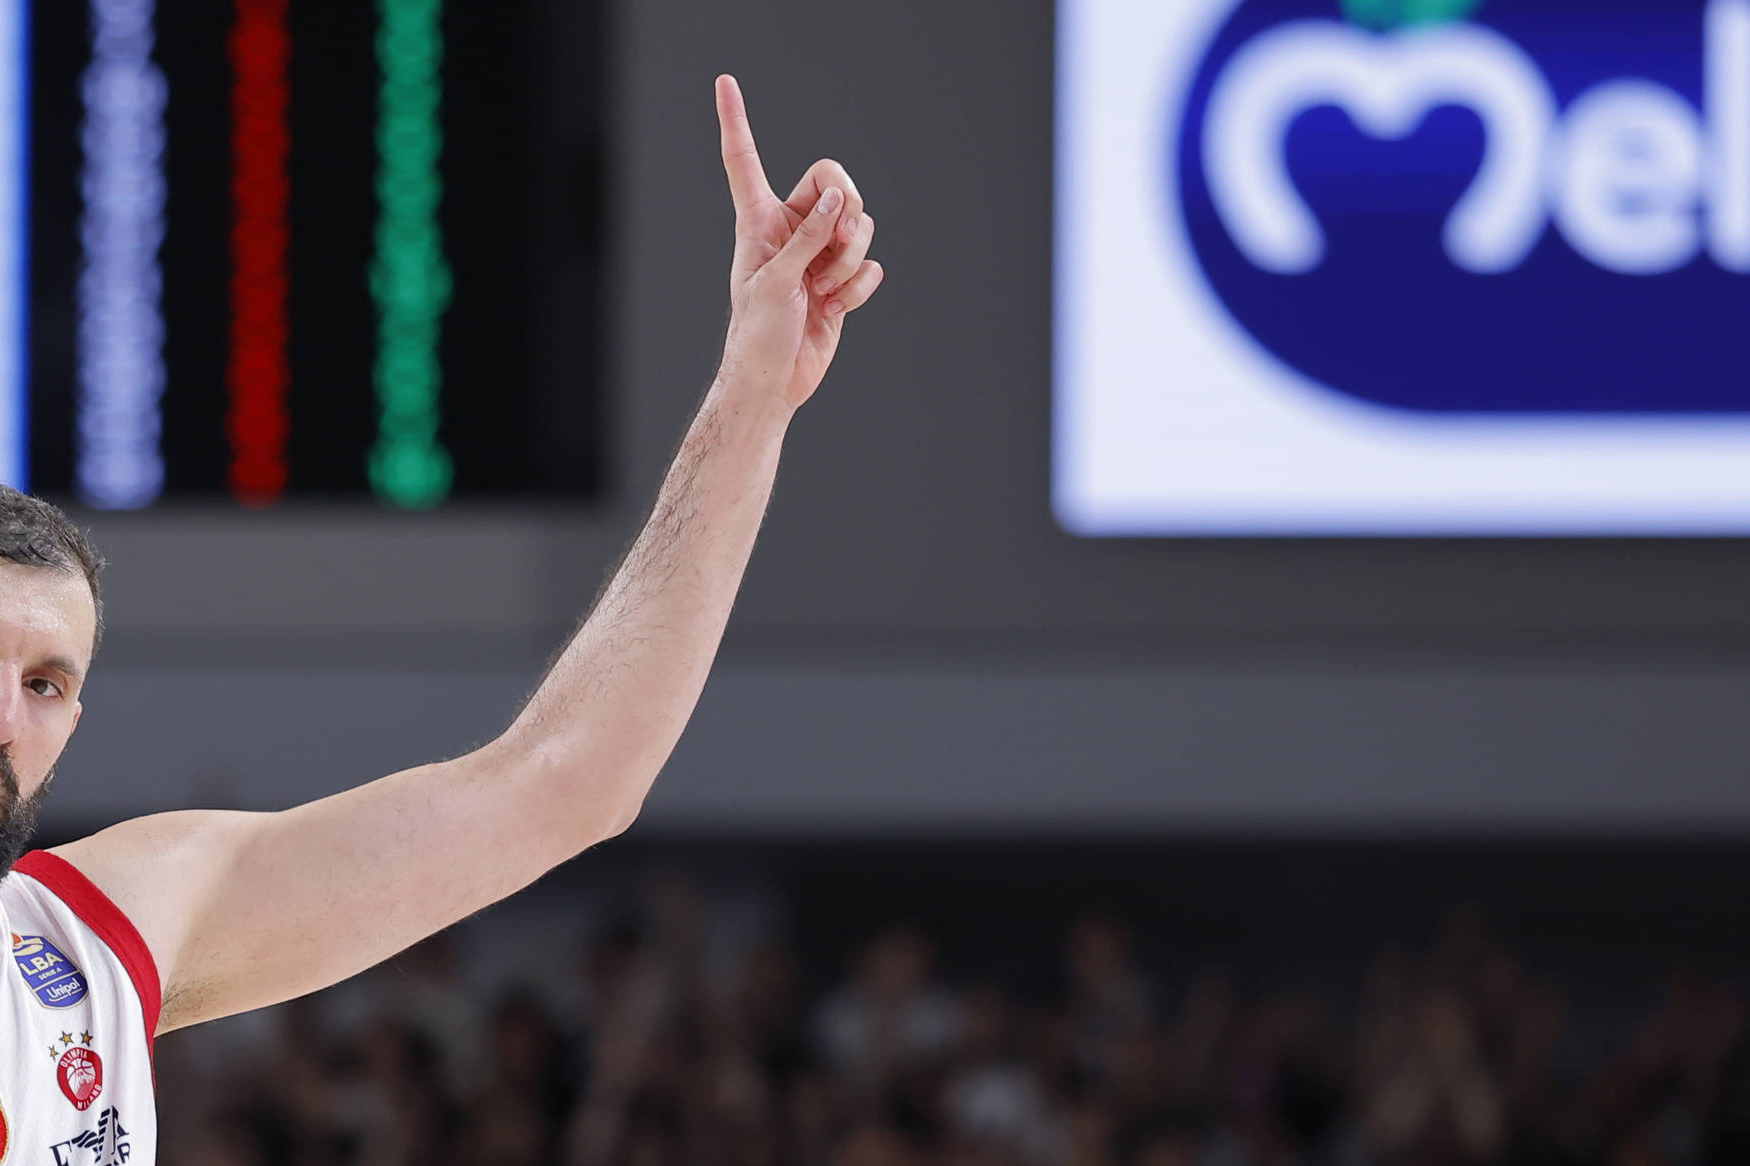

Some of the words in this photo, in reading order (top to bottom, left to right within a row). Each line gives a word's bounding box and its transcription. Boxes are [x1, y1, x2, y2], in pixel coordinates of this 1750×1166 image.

[19, 951, 64, 976] LBA
[38, 969, 56, 981] SERIE
[46, 978, 81, 997] Unipol
[60, 1048, 88, 1068] OLIMPIA
[77, 1083, 102, 1110] MILANO
